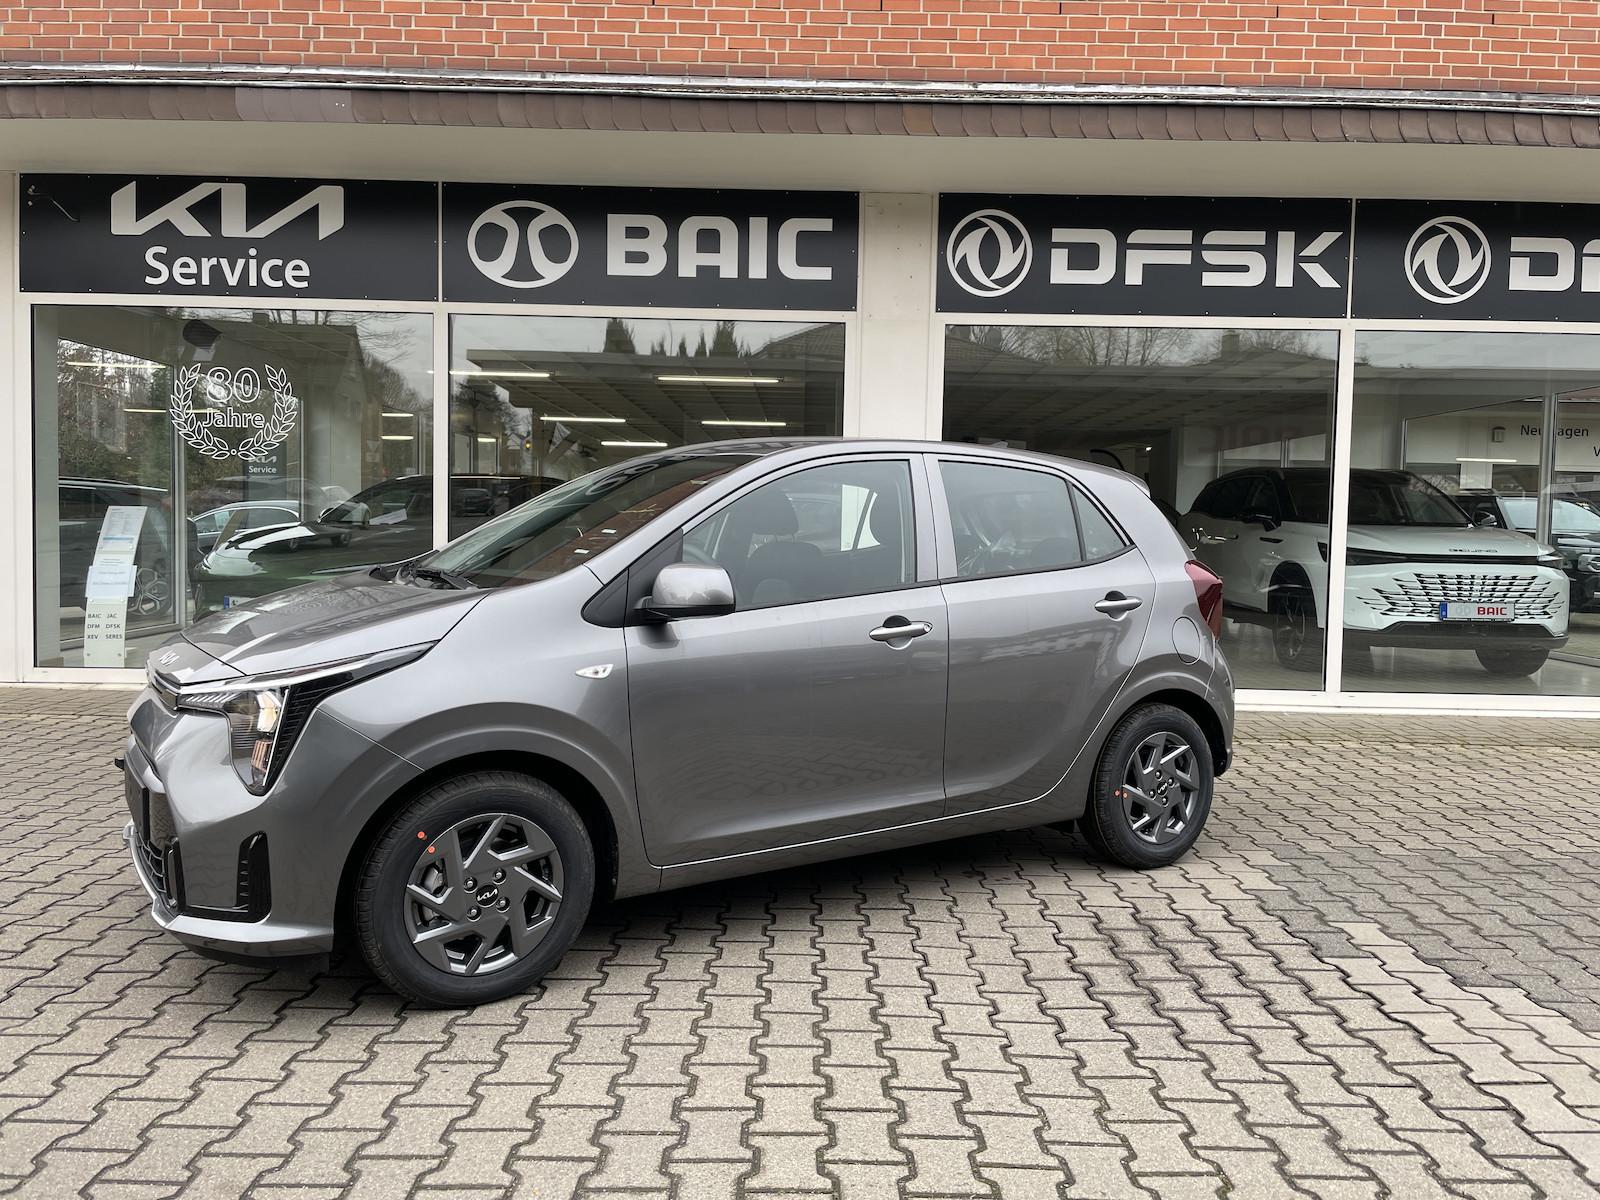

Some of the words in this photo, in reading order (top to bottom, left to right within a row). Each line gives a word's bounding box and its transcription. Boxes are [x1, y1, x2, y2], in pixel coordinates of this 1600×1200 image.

[111, 181, 344, 240] KIA
[606, 213, 833, 281] BAIC
[1049, 228, 1343, 288] DFSK
[144, 245, 310, 288] Service
[207, 367, 260, 403] 80
[203, 407, 265, 428] Jahre
[1520, 424, 1589, 440] Neagen
[248, 465, 277, 474] Service
[1477, 606, 1508, 616] BAIC
